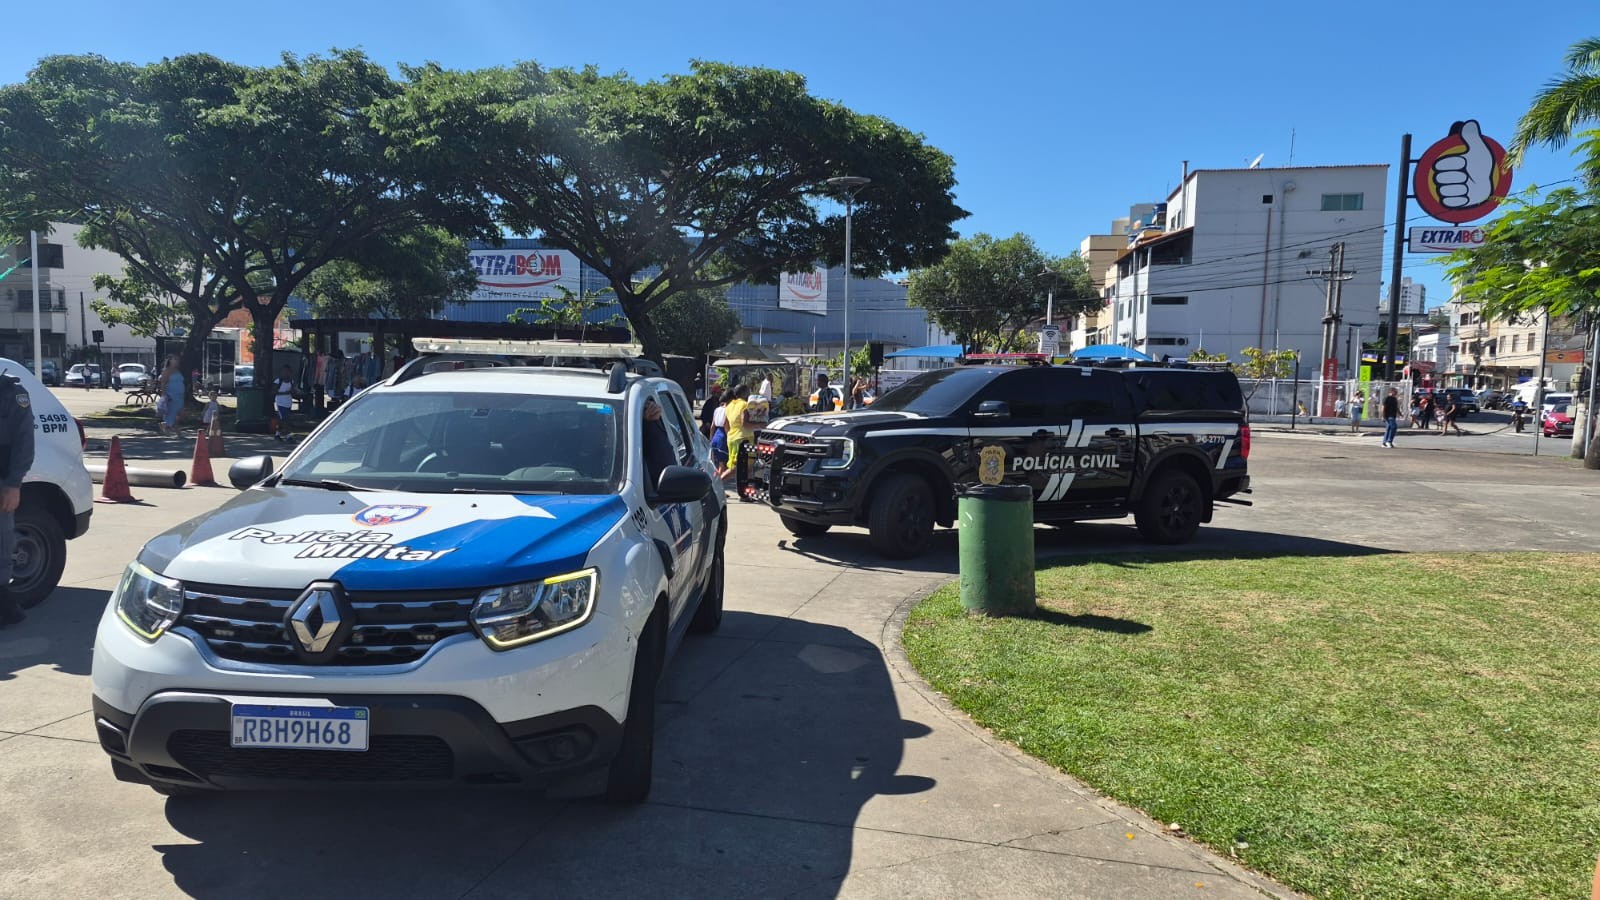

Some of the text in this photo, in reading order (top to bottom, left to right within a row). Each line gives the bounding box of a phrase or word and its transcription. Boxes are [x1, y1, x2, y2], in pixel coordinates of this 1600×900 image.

[1421, 229, 1488, 244] EXTRABO
[40, 414, 68, 423] 5498
[42, 423, 68, 433] BPM
[1012, 452, 1120, 471] POLÍCIA CIVIL
[228, 527, 393, 545] Polícia
[294, 542, 461, 561] Militar
[243, 718, 351, 745] RBH9H68
